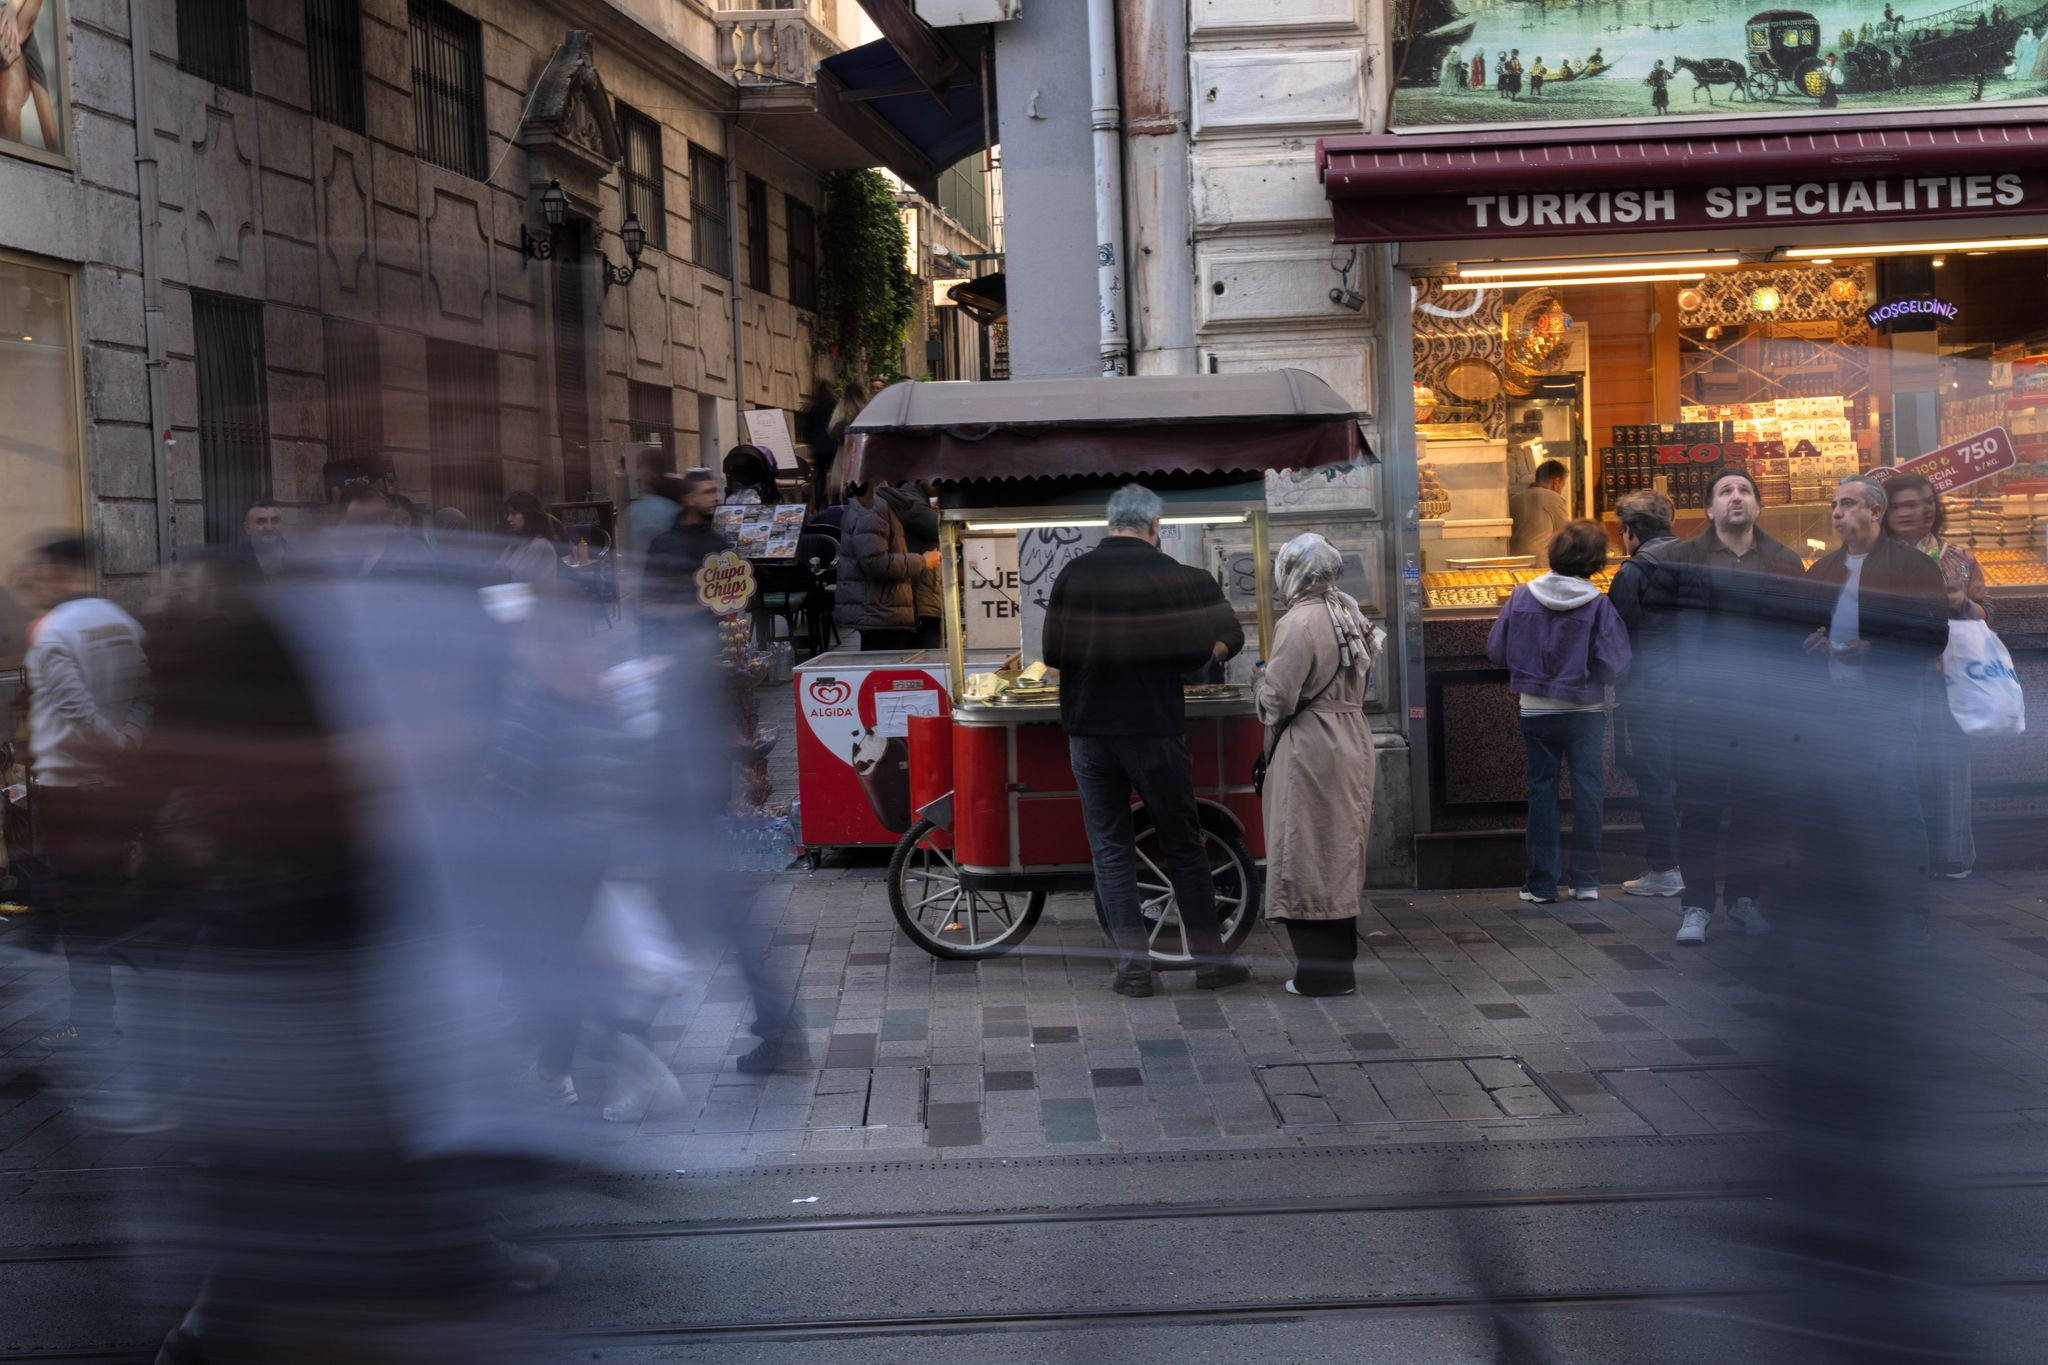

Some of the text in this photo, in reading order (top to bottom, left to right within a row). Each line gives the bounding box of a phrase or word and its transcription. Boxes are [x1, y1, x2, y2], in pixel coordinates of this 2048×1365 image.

[1467, 174, 2024, 227] TURKISH SPECIALITIES
[1656, 439, 1822, 465] KOSKA
[1957, 438, 1998, 464] 750
[704, 565, 745, 583] Chupa
[704, 580, 747, 600] Chups
